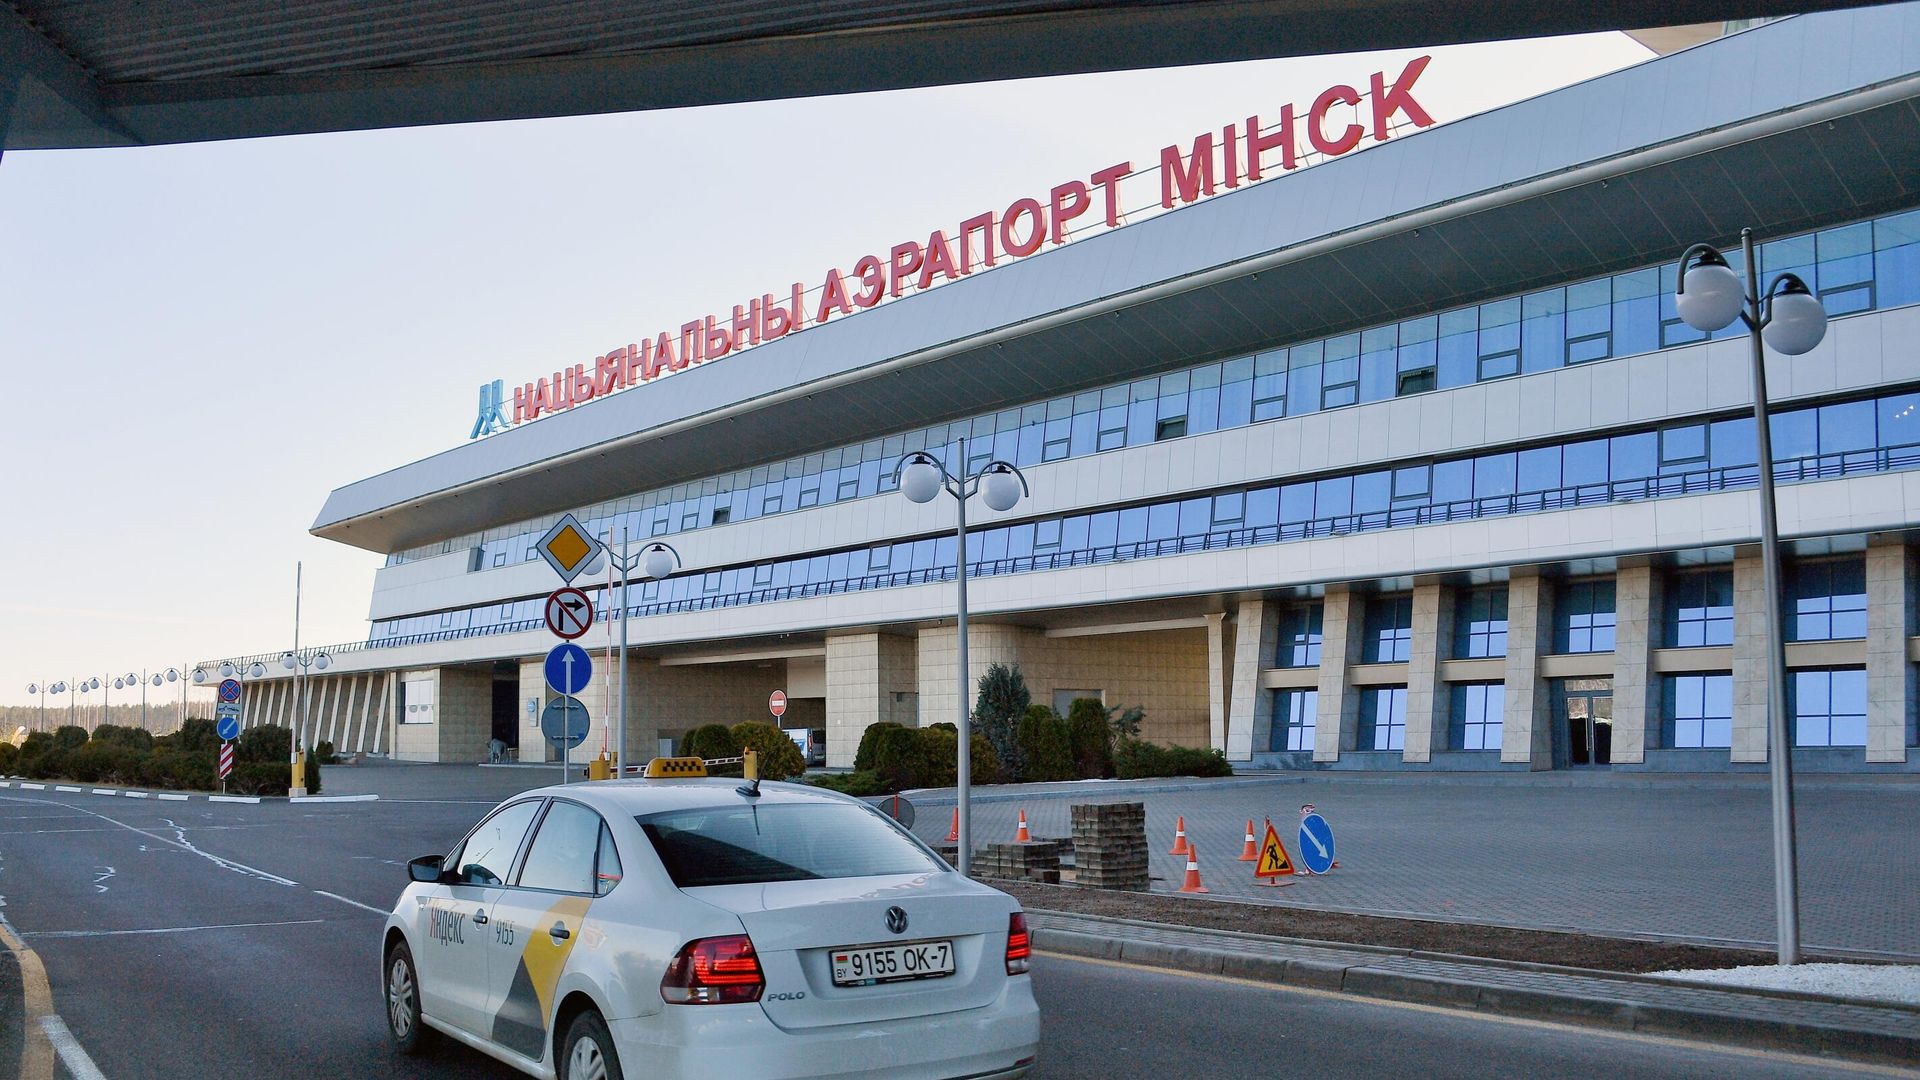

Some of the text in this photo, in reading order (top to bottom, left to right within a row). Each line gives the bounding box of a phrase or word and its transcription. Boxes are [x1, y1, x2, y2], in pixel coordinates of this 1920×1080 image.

[513, 55, 1437, 425] НАЦЫЯНАЛЬНЫ АЭРАПОРТ МІНСК
[429, 906, 466, 946] Яндекс
[496, 919, 515, 946] 9155
[836, 968, 848, 979] BY
[851, 945, 948, 977] 9155 OK-7
[767, 991, 805, 1001] POLO
